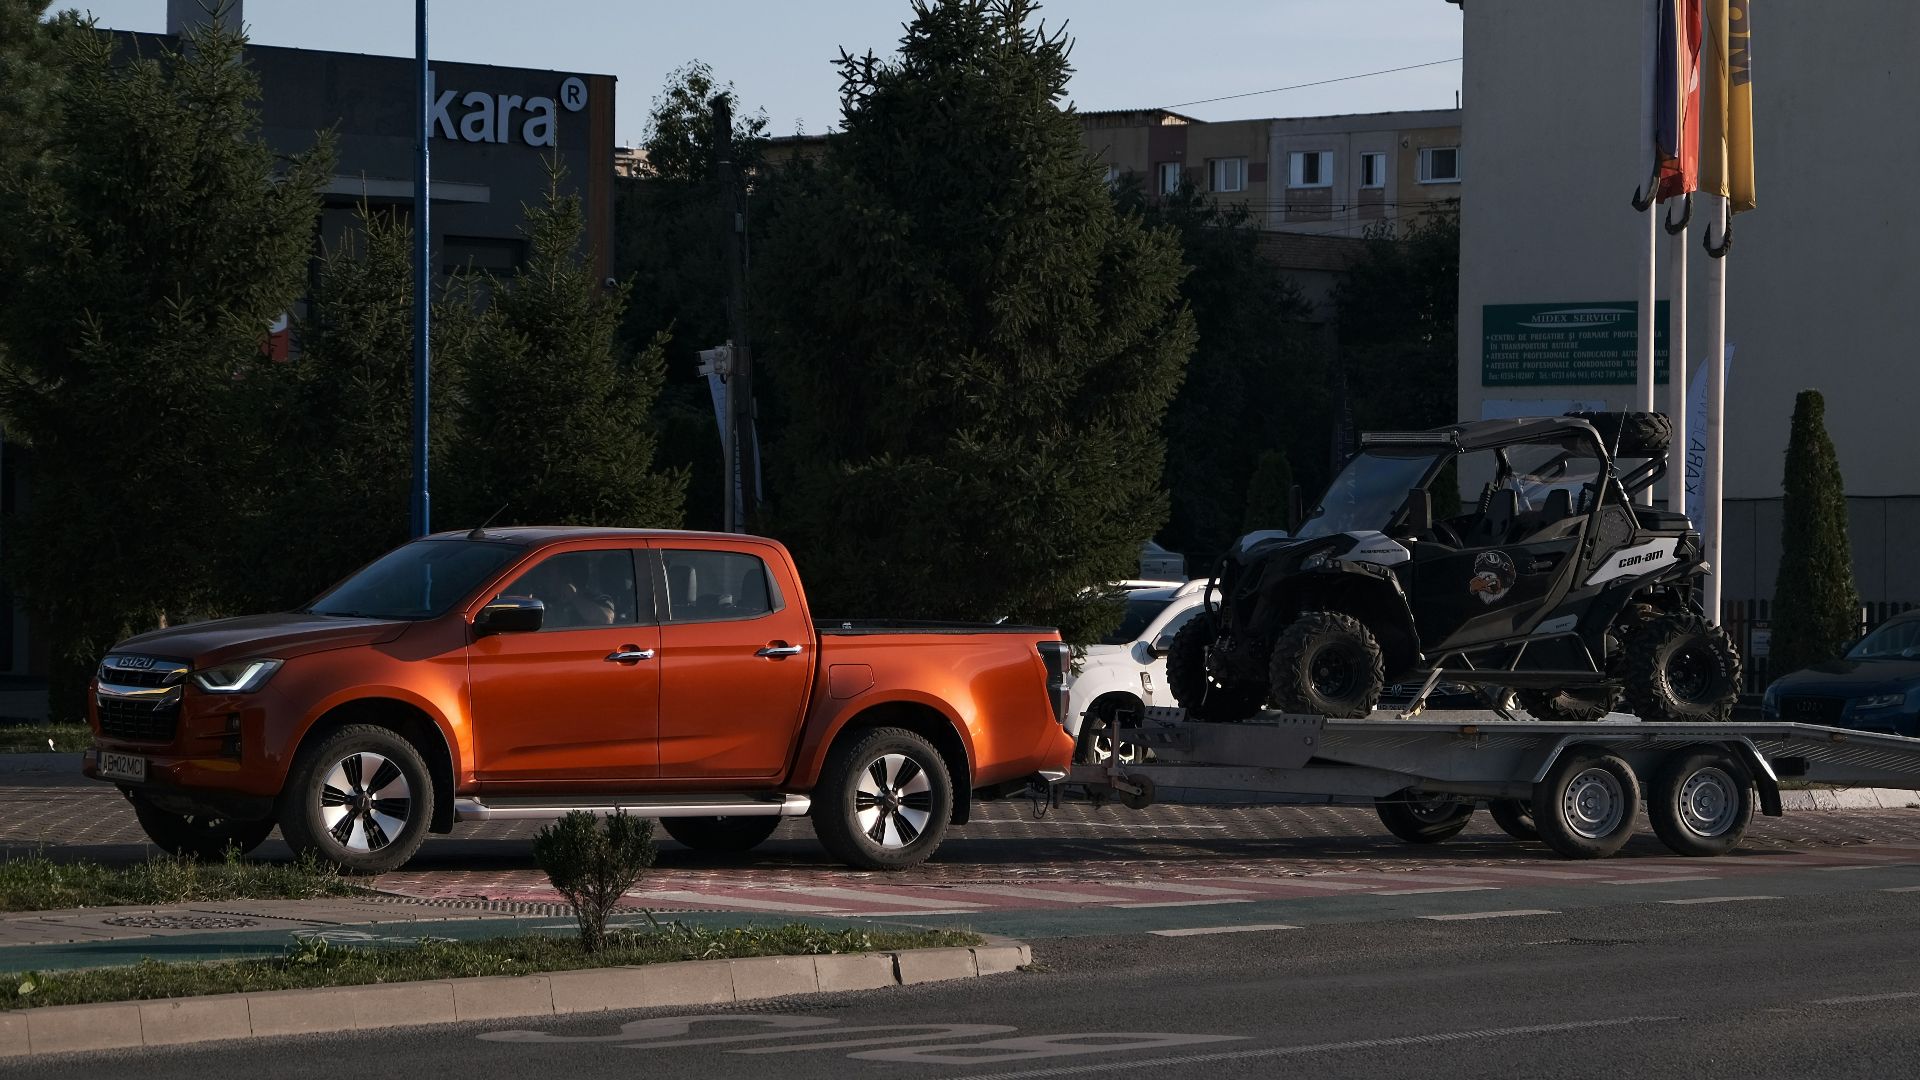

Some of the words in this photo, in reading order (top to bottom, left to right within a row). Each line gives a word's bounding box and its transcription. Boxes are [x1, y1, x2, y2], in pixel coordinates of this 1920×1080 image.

[427, 70, 555, 147] kara
[1531, 314, 1567, 323] MIDEX
[1573, 313, 1621, 322] SERVICII
[1490, 333, 1515, 341] CENTRU
[1518, 333, 1527, 341] DE
[1578, 331, 1610, 339] FORMARE
[1501, 342, 1548, 350] TRANSPORTURI
[1490, 352, 1520, 360] ATESTATE
[1523, 351, 1570, 359] PROFESIONALE
[1523, 361, 1570, 369] PROFESIONALE
[1573, 360, 1623, 368] COORDONATORI
[119, 656, 155, 668] ISUZU
[1708, 643, 1726, 678] MAXXIS
